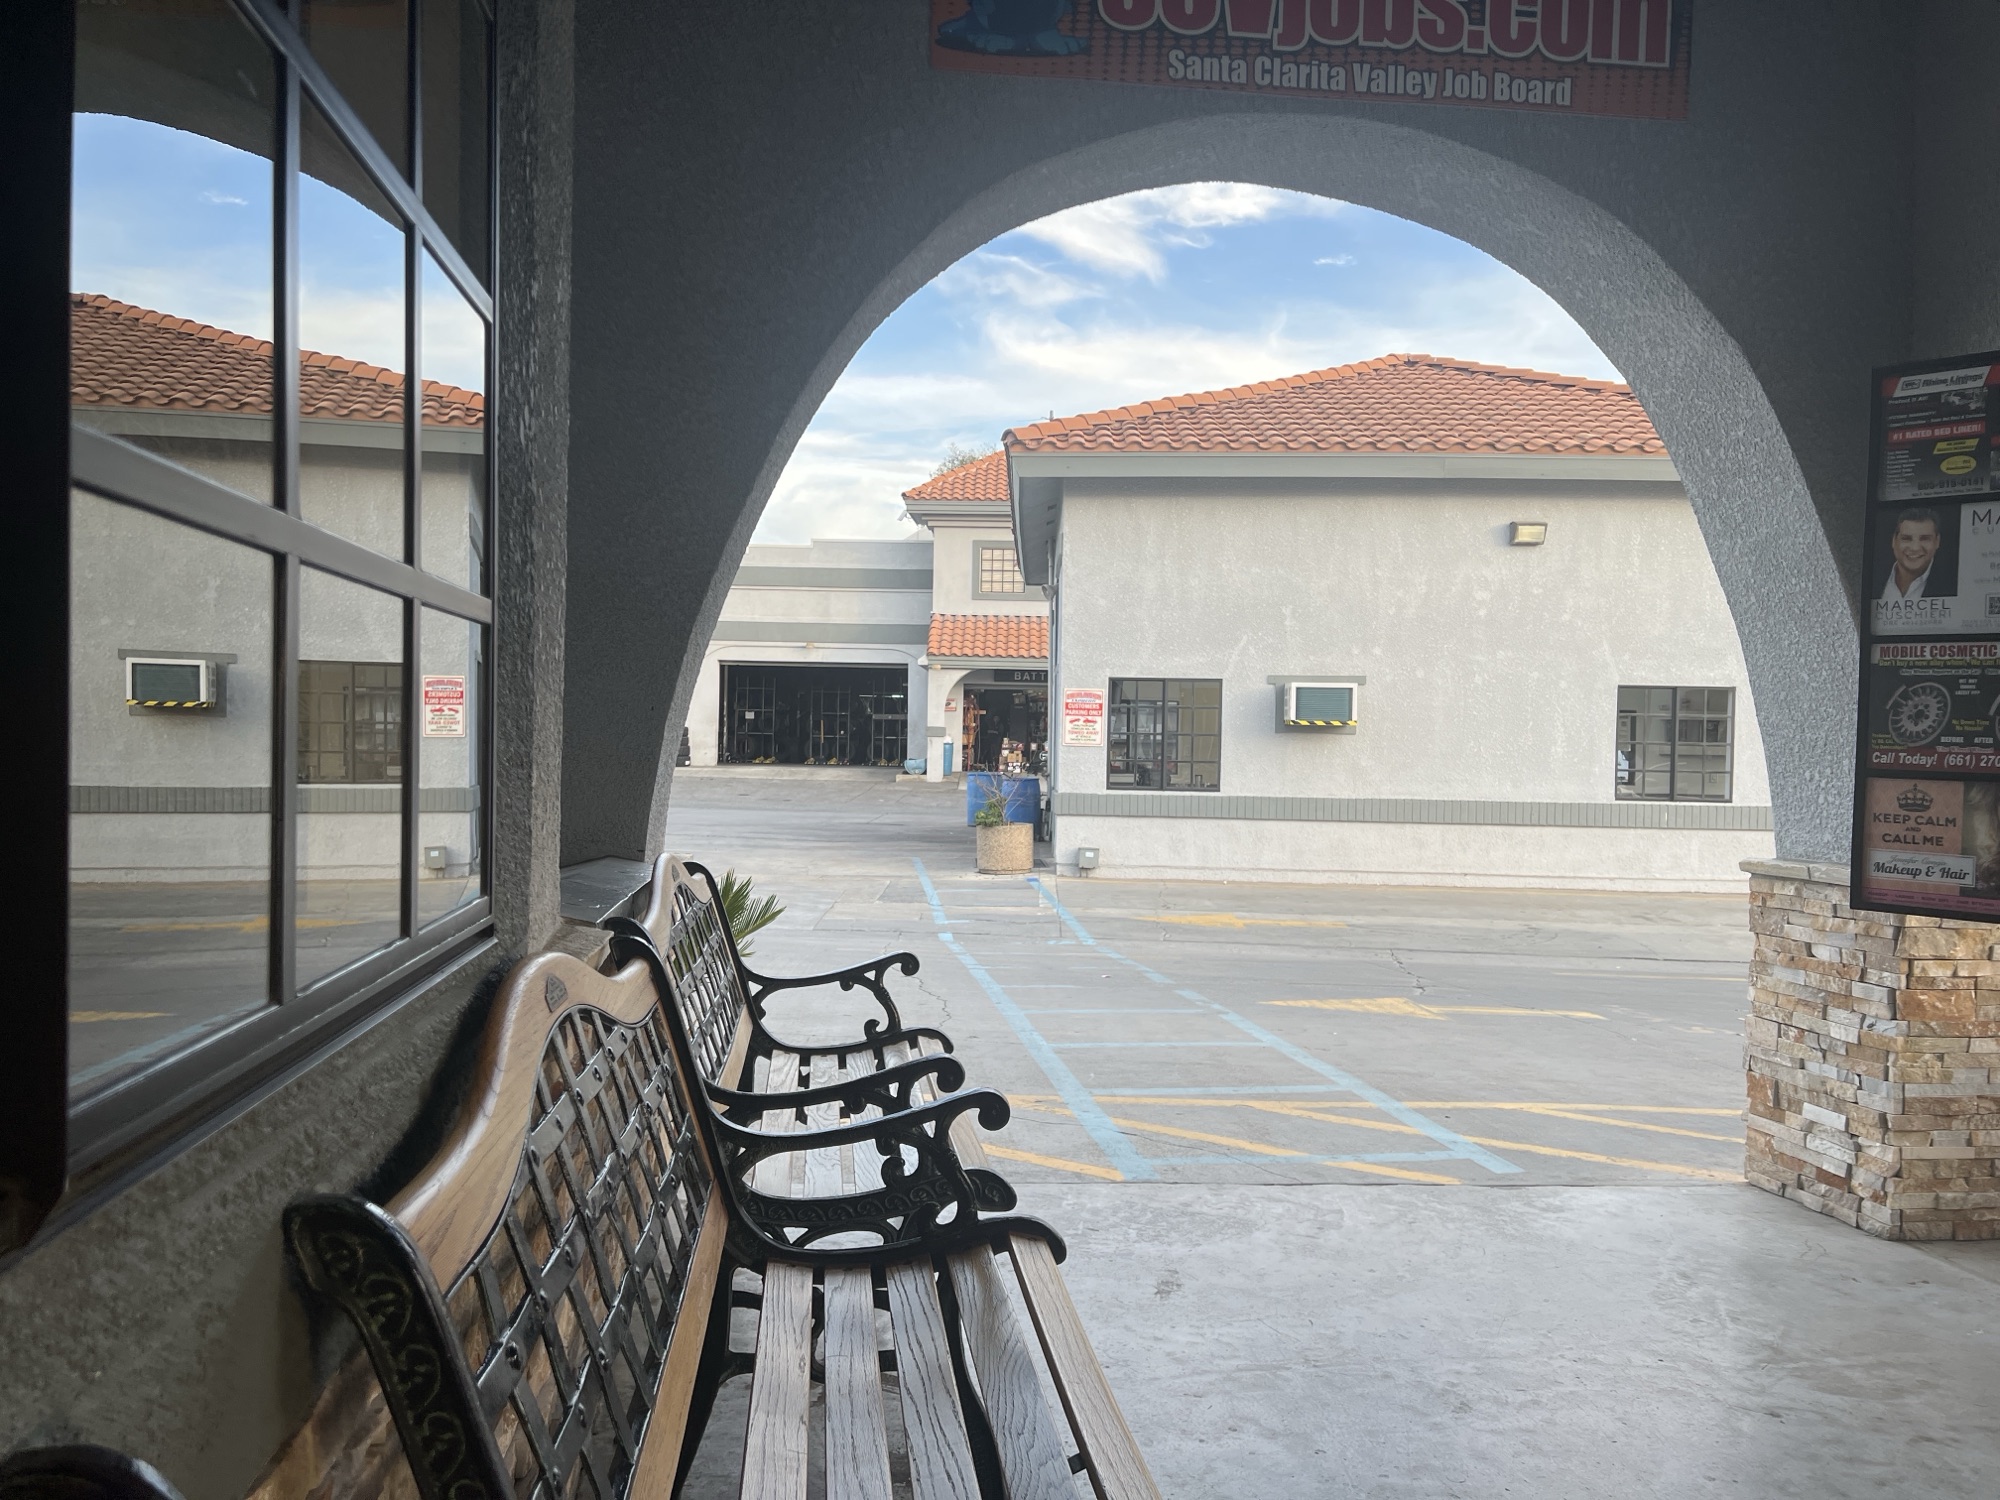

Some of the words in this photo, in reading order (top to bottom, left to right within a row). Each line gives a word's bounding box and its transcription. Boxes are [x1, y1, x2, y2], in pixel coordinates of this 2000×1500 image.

[1168, 49, 1247, 84] Santa
[1254, 55, 1346, 91] Clarita
[1352, 62, 1438, 99] Valley
[1443, 68, 1487, 99] Job
[1493, 71, 1572, 106] Board
[1876, 599, 1951, 611] MARCEL
[1876, 609, 1952, 620] CUSCHIERI
[1880, 645, 1926, 658] MOBILE
[1929, 644, 1997, 658] COSMETIC
[1872, 752, 1895, 764] Call
[1898, 752, 1938, 767] Today!
[1944, 754, 1976, 768] (661)
[1873, 812, 1911, 824] KEEP
[1915, 815, 1957, 827] CALM
[1882, 833, 1920, 844] CALL
[1922, 835, 1944, 846] ME
[1873, 861, 1922, 879] Makeup
[1925, 865, 1936, 878] &
[1938, 866, 1970, 881] Hair
